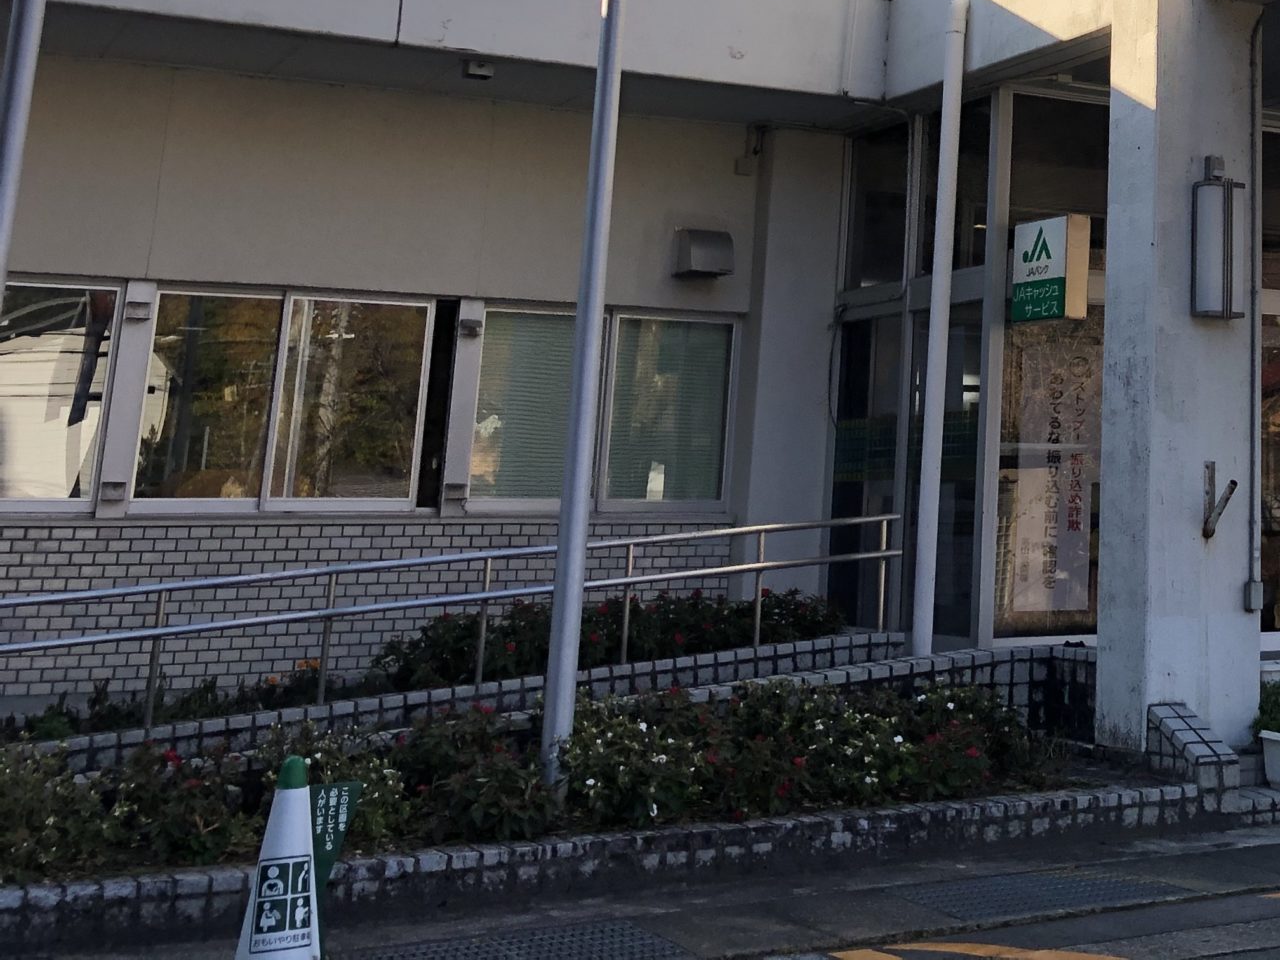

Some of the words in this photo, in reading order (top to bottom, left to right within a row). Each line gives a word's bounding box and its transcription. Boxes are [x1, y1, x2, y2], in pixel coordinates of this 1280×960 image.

[1026, 265, 1049, 277] JAバンク
[1013, 285, 1059, 302] JAキャッシュ
[1025, 301, 1058, 317] サービス
[1066, 453, 1083, 532] 振り込め詐欺
[316, 788, 327, 835] 人がいます
[325, 787, 338, 851] 必要としている
